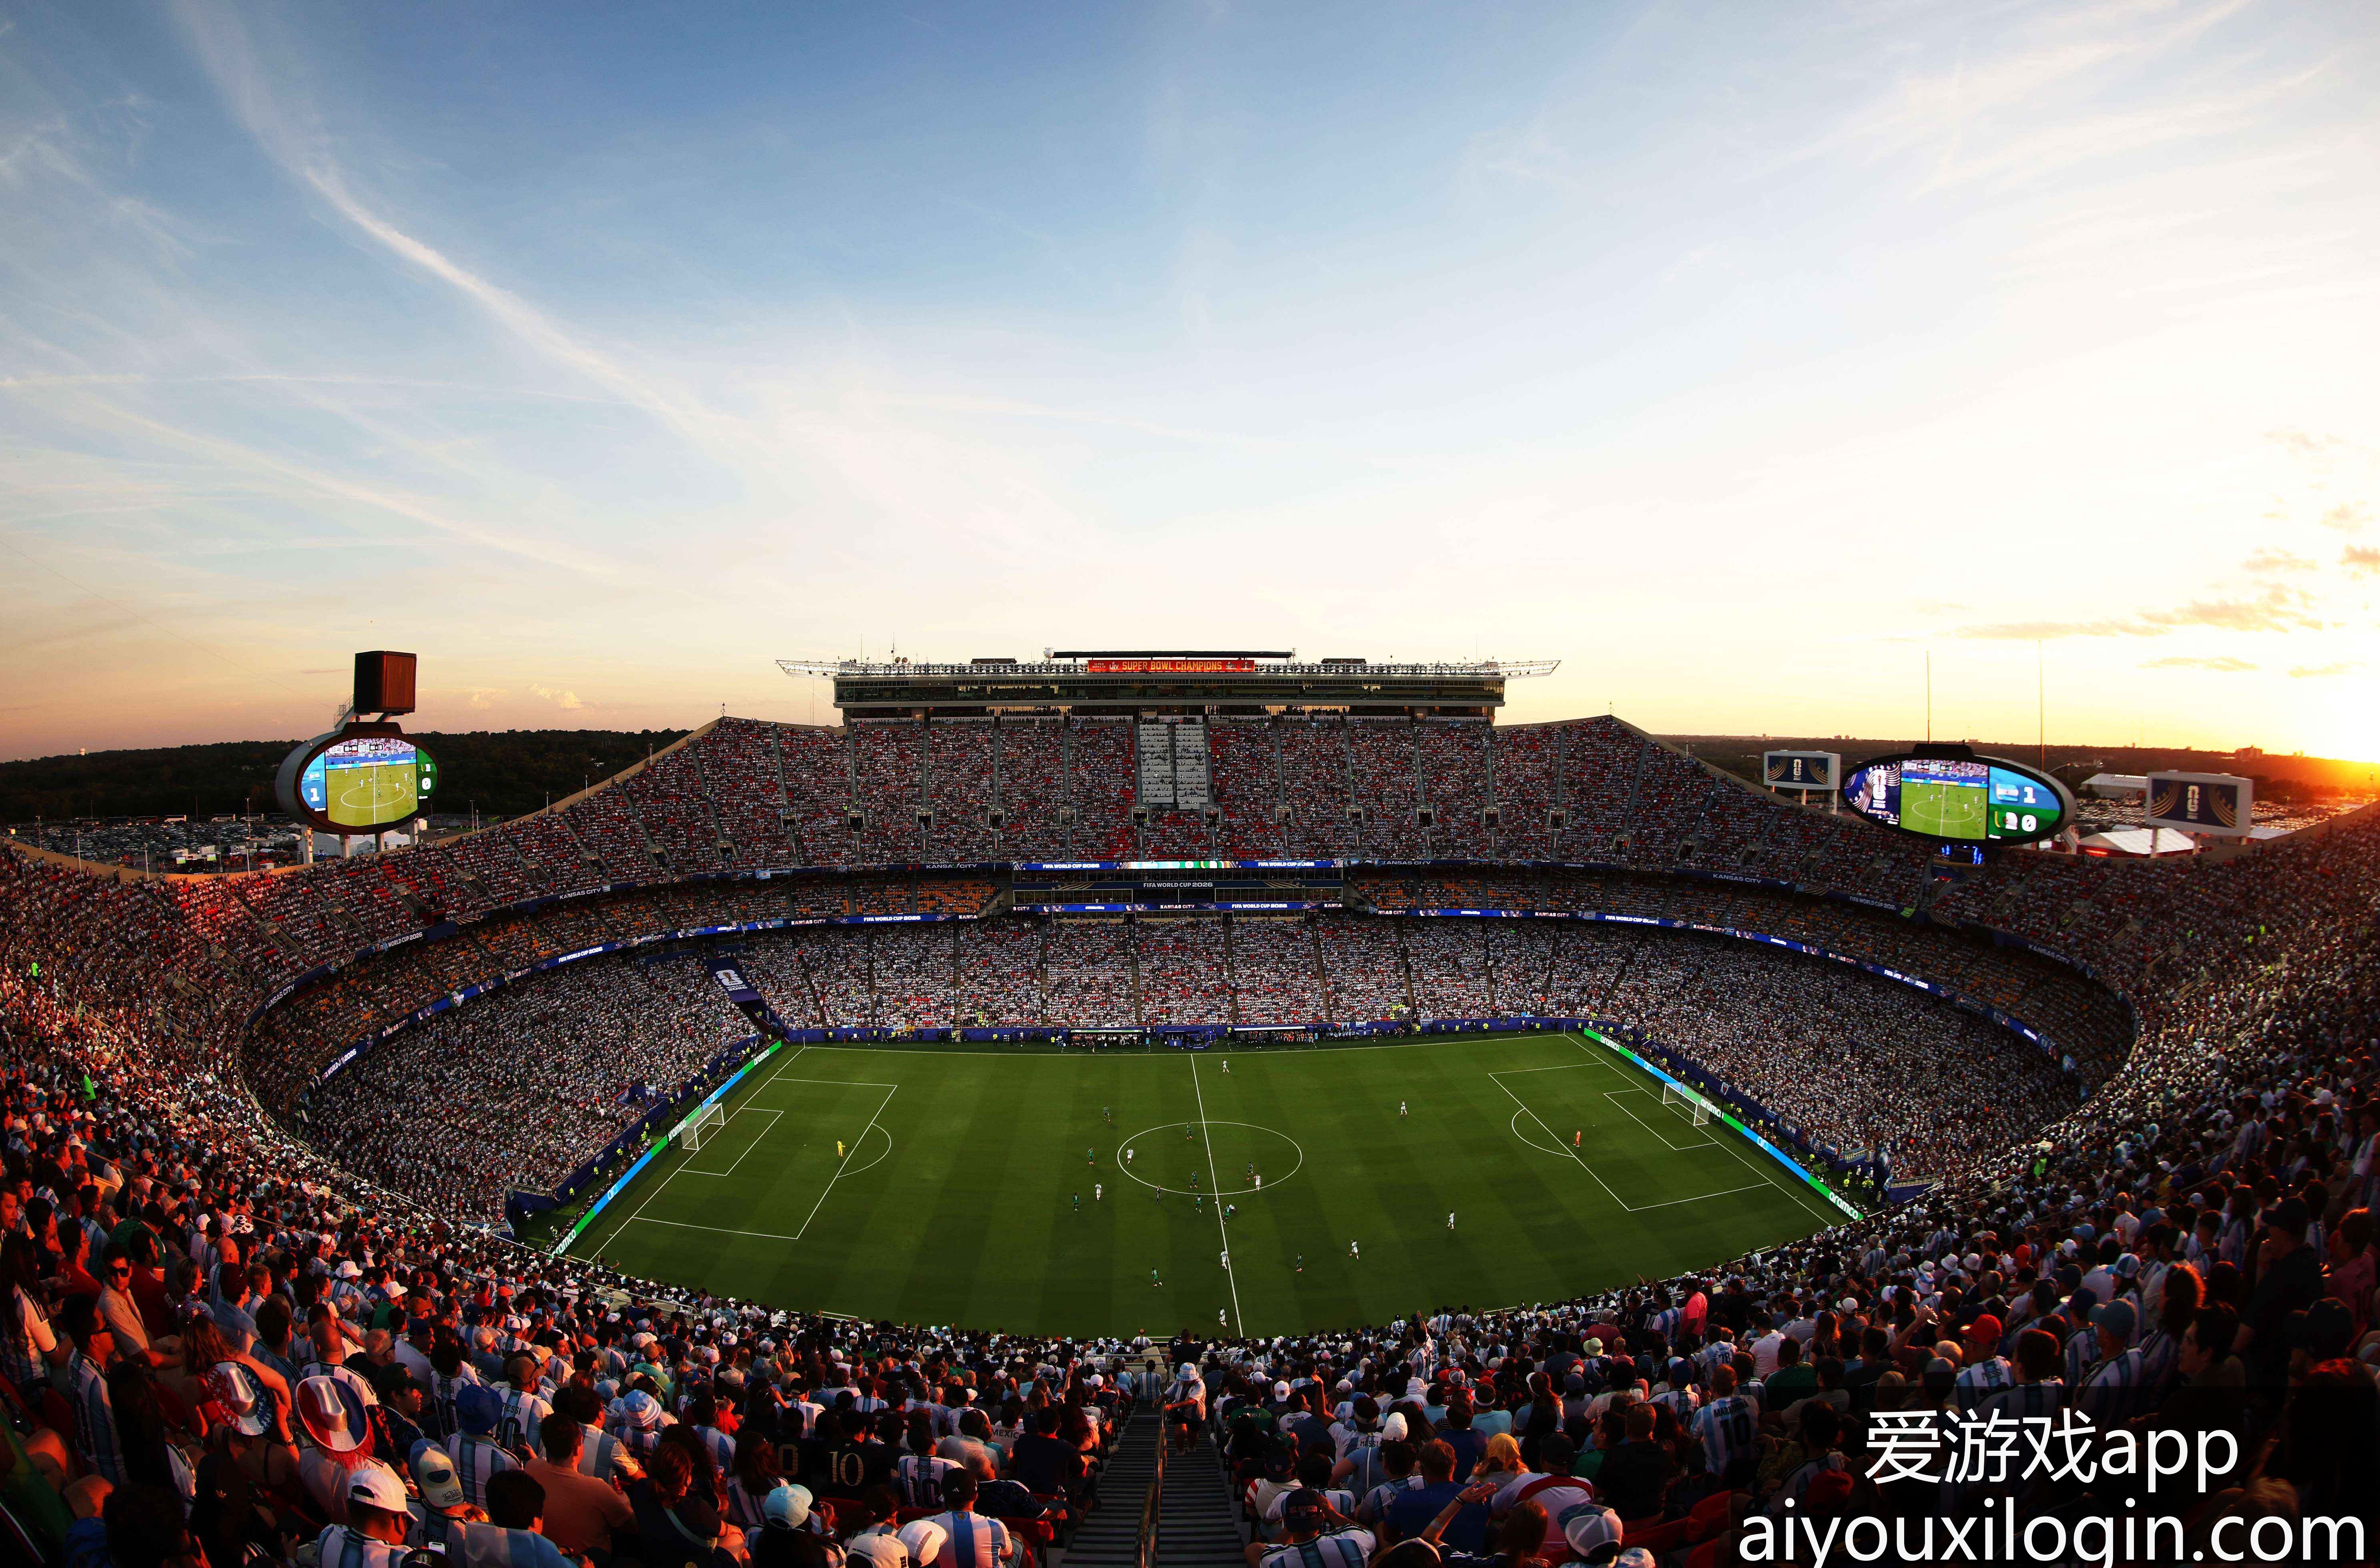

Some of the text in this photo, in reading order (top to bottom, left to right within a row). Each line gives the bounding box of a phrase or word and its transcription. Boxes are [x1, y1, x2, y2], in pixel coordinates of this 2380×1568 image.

[1122, 661, 1149, 670] SUPER
[1151, 661, 1174, 670] BOWL
[1176, 661, 1222, 670] CHAMPIONS
[422, 777, 431, 790] 0
[311, 788, 320, 802] 1
[2024, 787, 2036, 804] 1
[2022, 815, 2036, 832] 0
[1713, 874, 1744, 882] KANSAS
[559, 890, 585, 899] KANSAS
[388, 938, 401, 948] WORLD
[409, 932, 423, 940] 2026
[567, 953, 580, 961] WORLD
[283, 984, 295, 996] CITY
[1600, 1036, 1620, 1051] aramco
[754, 1049, 770, 1066] aramco
[1701, 1098, 1724, 1118] aramco
[596, 1153, 604, 1163] FIFA
[1829, 1192, 1859, 1220] aramco
[880, 1341, 892, 1351] 10
[1718, 1352, 1730, 1364] 78
[437, 1383, 454, 1394] MESSI
[501, 1402, 522, 1415] MESSI
[1714, 1401, 1749, 1417] MARADONA
[992, 1429, 1021, 1440] MEXIC
[1720, 1413, 1750, 1450] 10
[829, 1451, 865, 1486] 10
[914, 1464, 934, 1474] MESSI
[910, 1476, 942, 1508] 10
